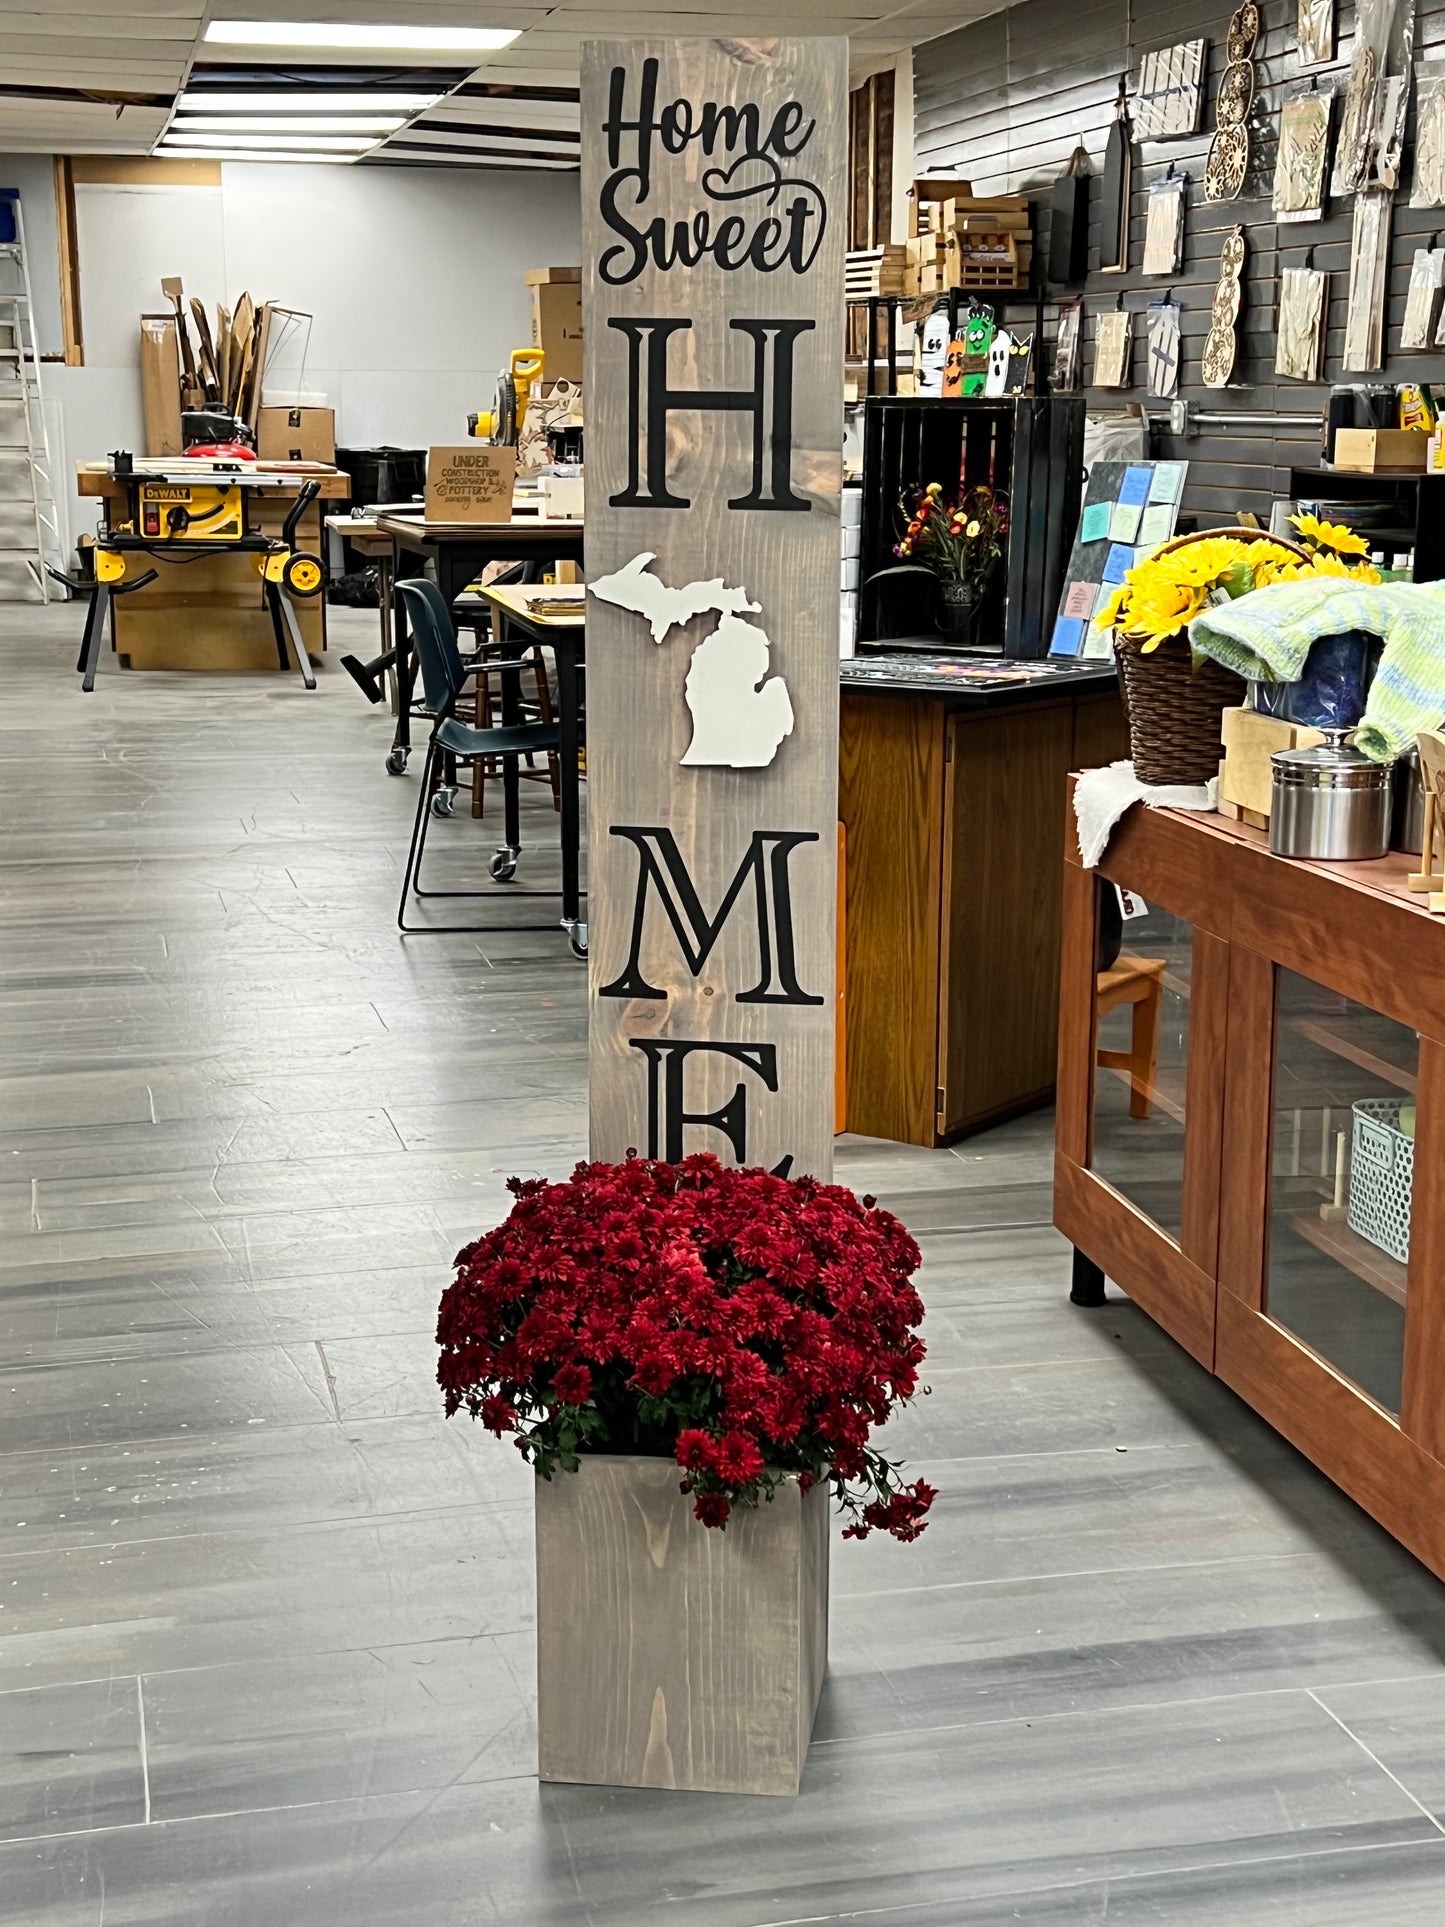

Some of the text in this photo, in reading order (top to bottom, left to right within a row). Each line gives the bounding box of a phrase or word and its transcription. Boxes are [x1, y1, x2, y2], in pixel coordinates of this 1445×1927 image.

[602, 58, 816, 172] Home
[599, 168, 827, 286] Sweet
[448, 486, 489, 495] POTTERY
[453, 455, 490, 468] UNDER
